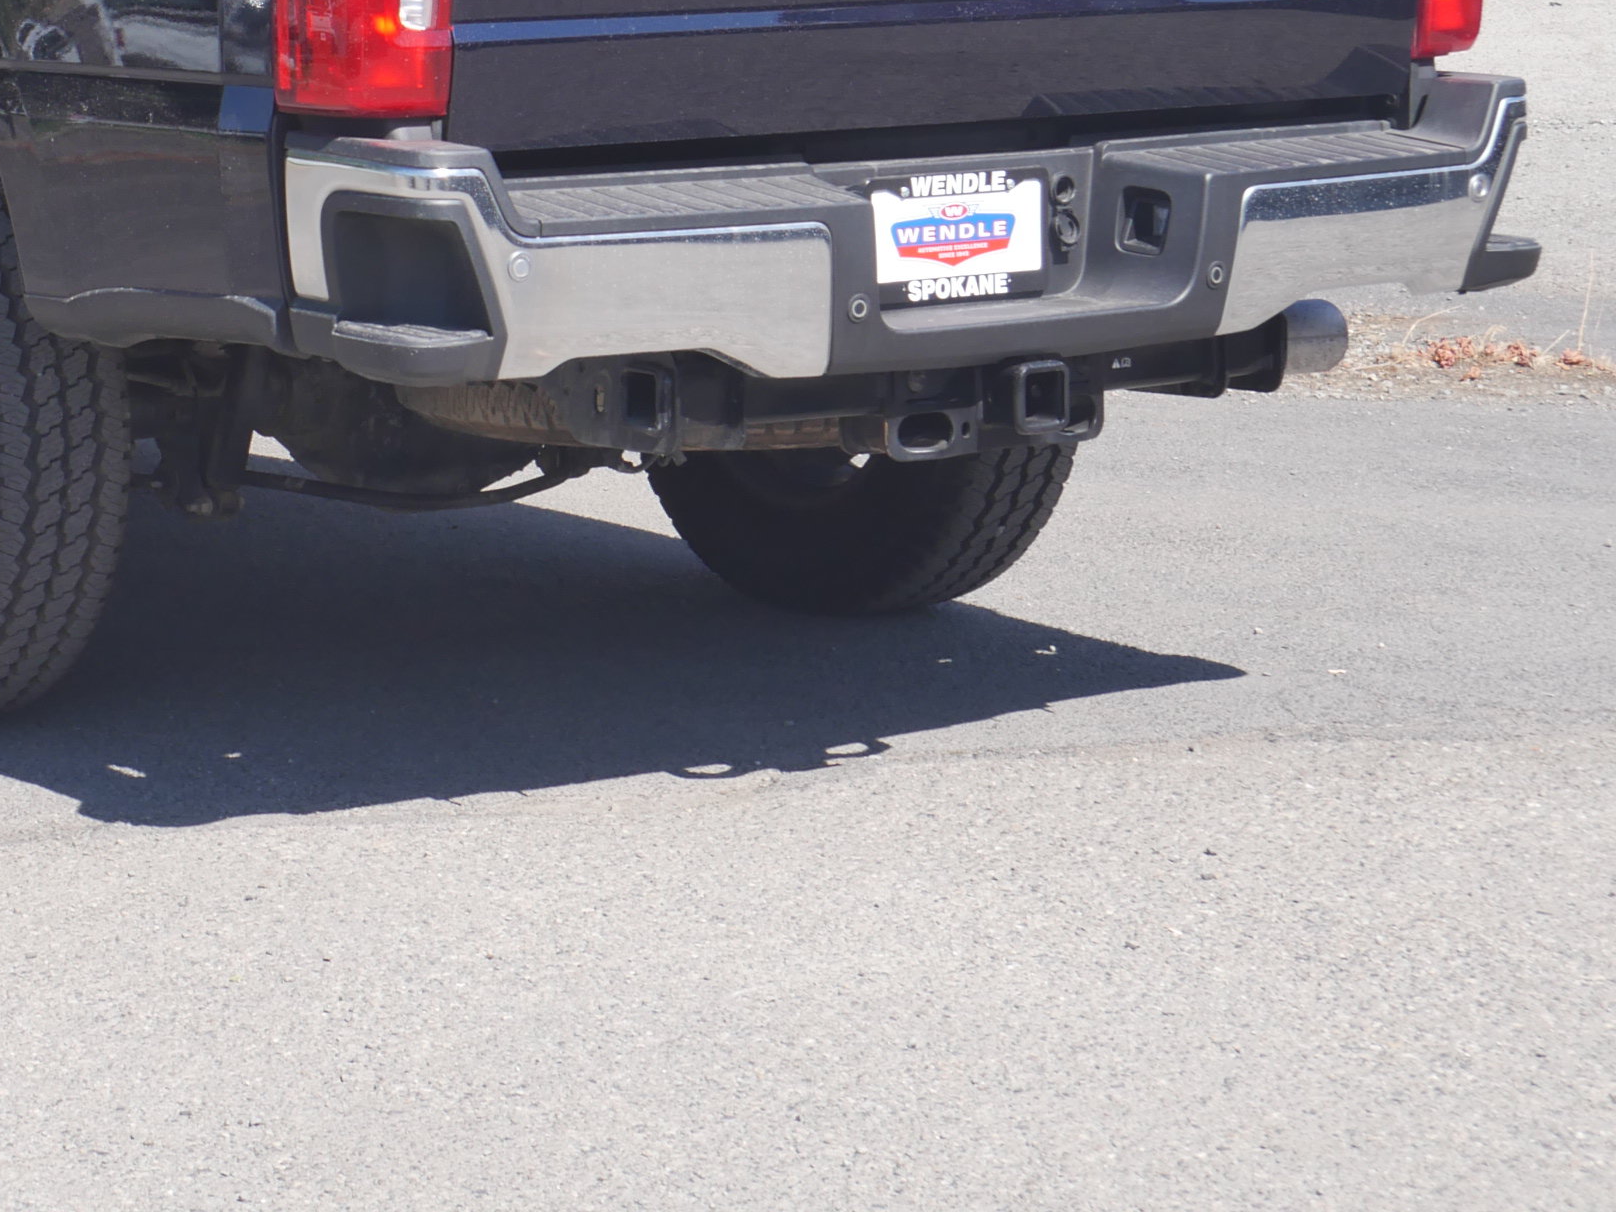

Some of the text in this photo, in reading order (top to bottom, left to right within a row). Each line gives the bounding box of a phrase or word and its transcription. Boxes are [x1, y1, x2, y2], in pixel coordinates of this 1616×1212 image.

[911, 171, 1006, 197] WENDLE
[896, 221, 1007, 244] WENDLE
[908, 273, 1008, 301] SPOKANE
